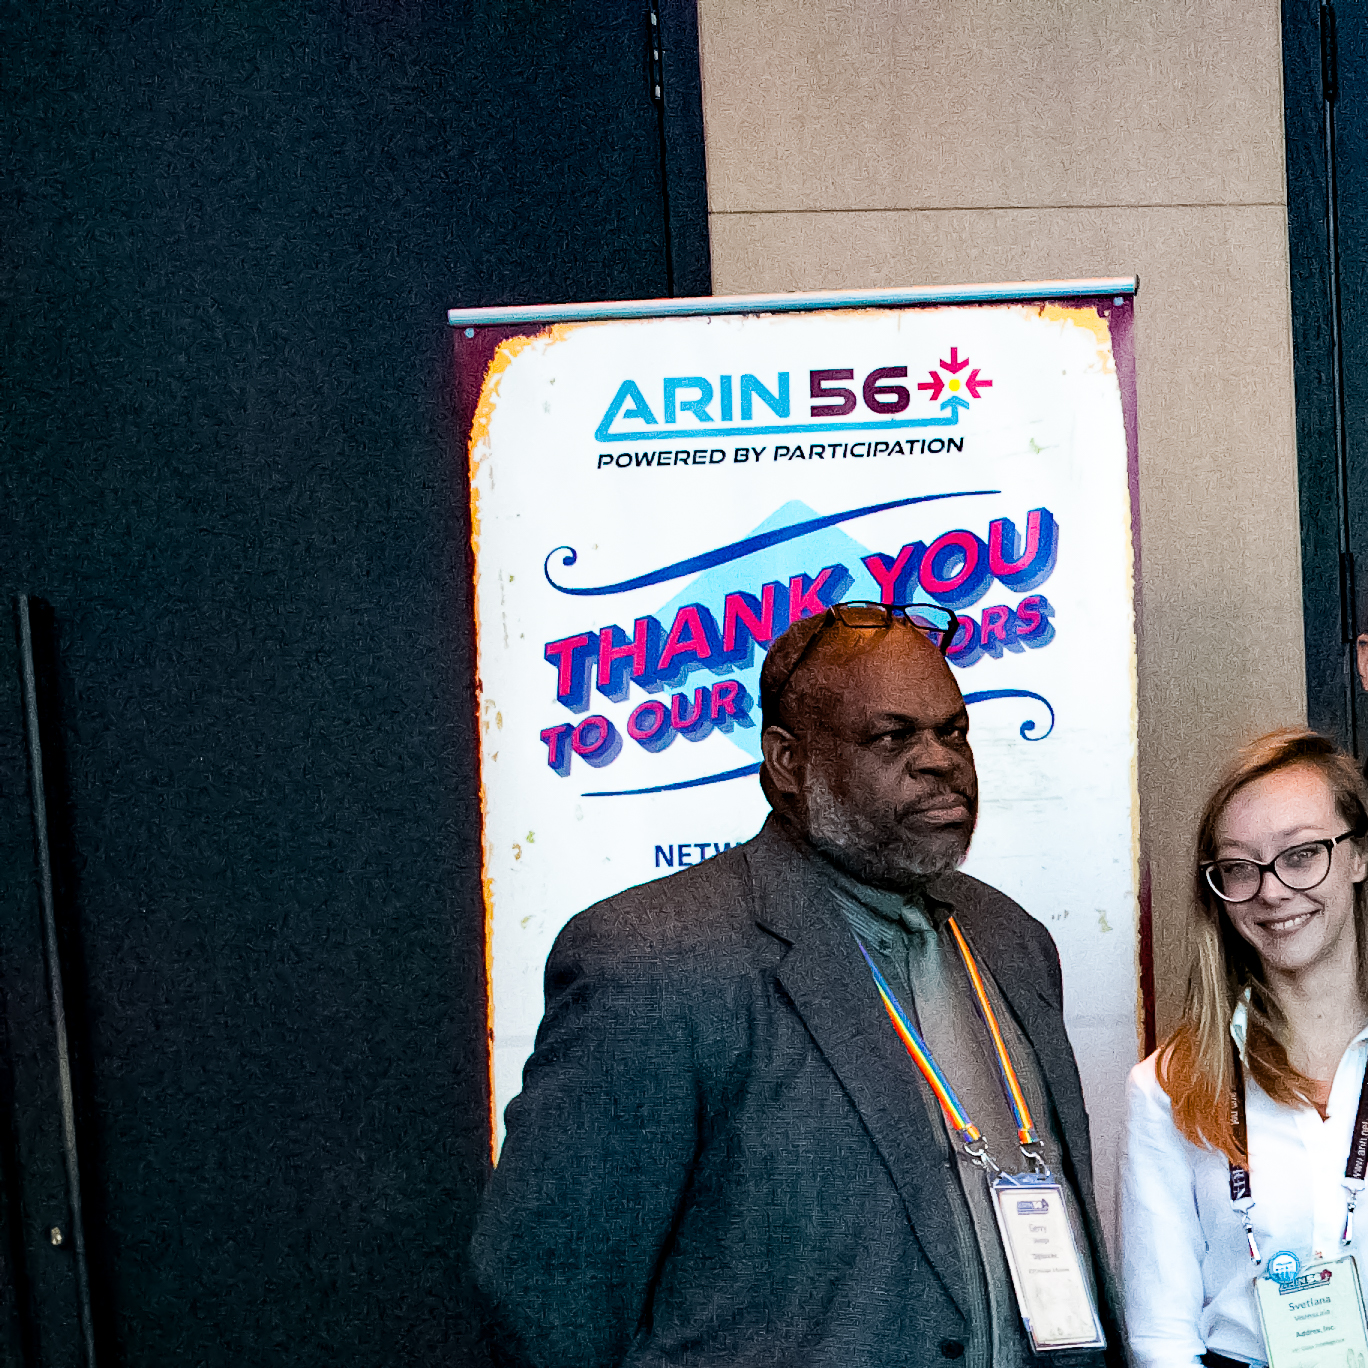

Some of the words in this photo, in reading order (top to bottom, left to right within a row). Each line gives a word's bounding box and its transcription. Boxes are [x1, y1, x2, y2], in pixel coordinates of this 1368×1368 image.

[595, 371, 791, 437] ARIN
[809, 365, 911, 418] 56
[597, 448, 726, 470] POWERED
[733, 446, 767, 464] BY
[773, 437, 965, 462] PARTICIPATION
[544, 564, 855, 714] THANK
[862, 507, 1060, 607] YOU
[540, 713, 624, 777] TO
[627, 679, 757, 754] OUR
[1288, 1296, 1332, 1312] Svetlana
